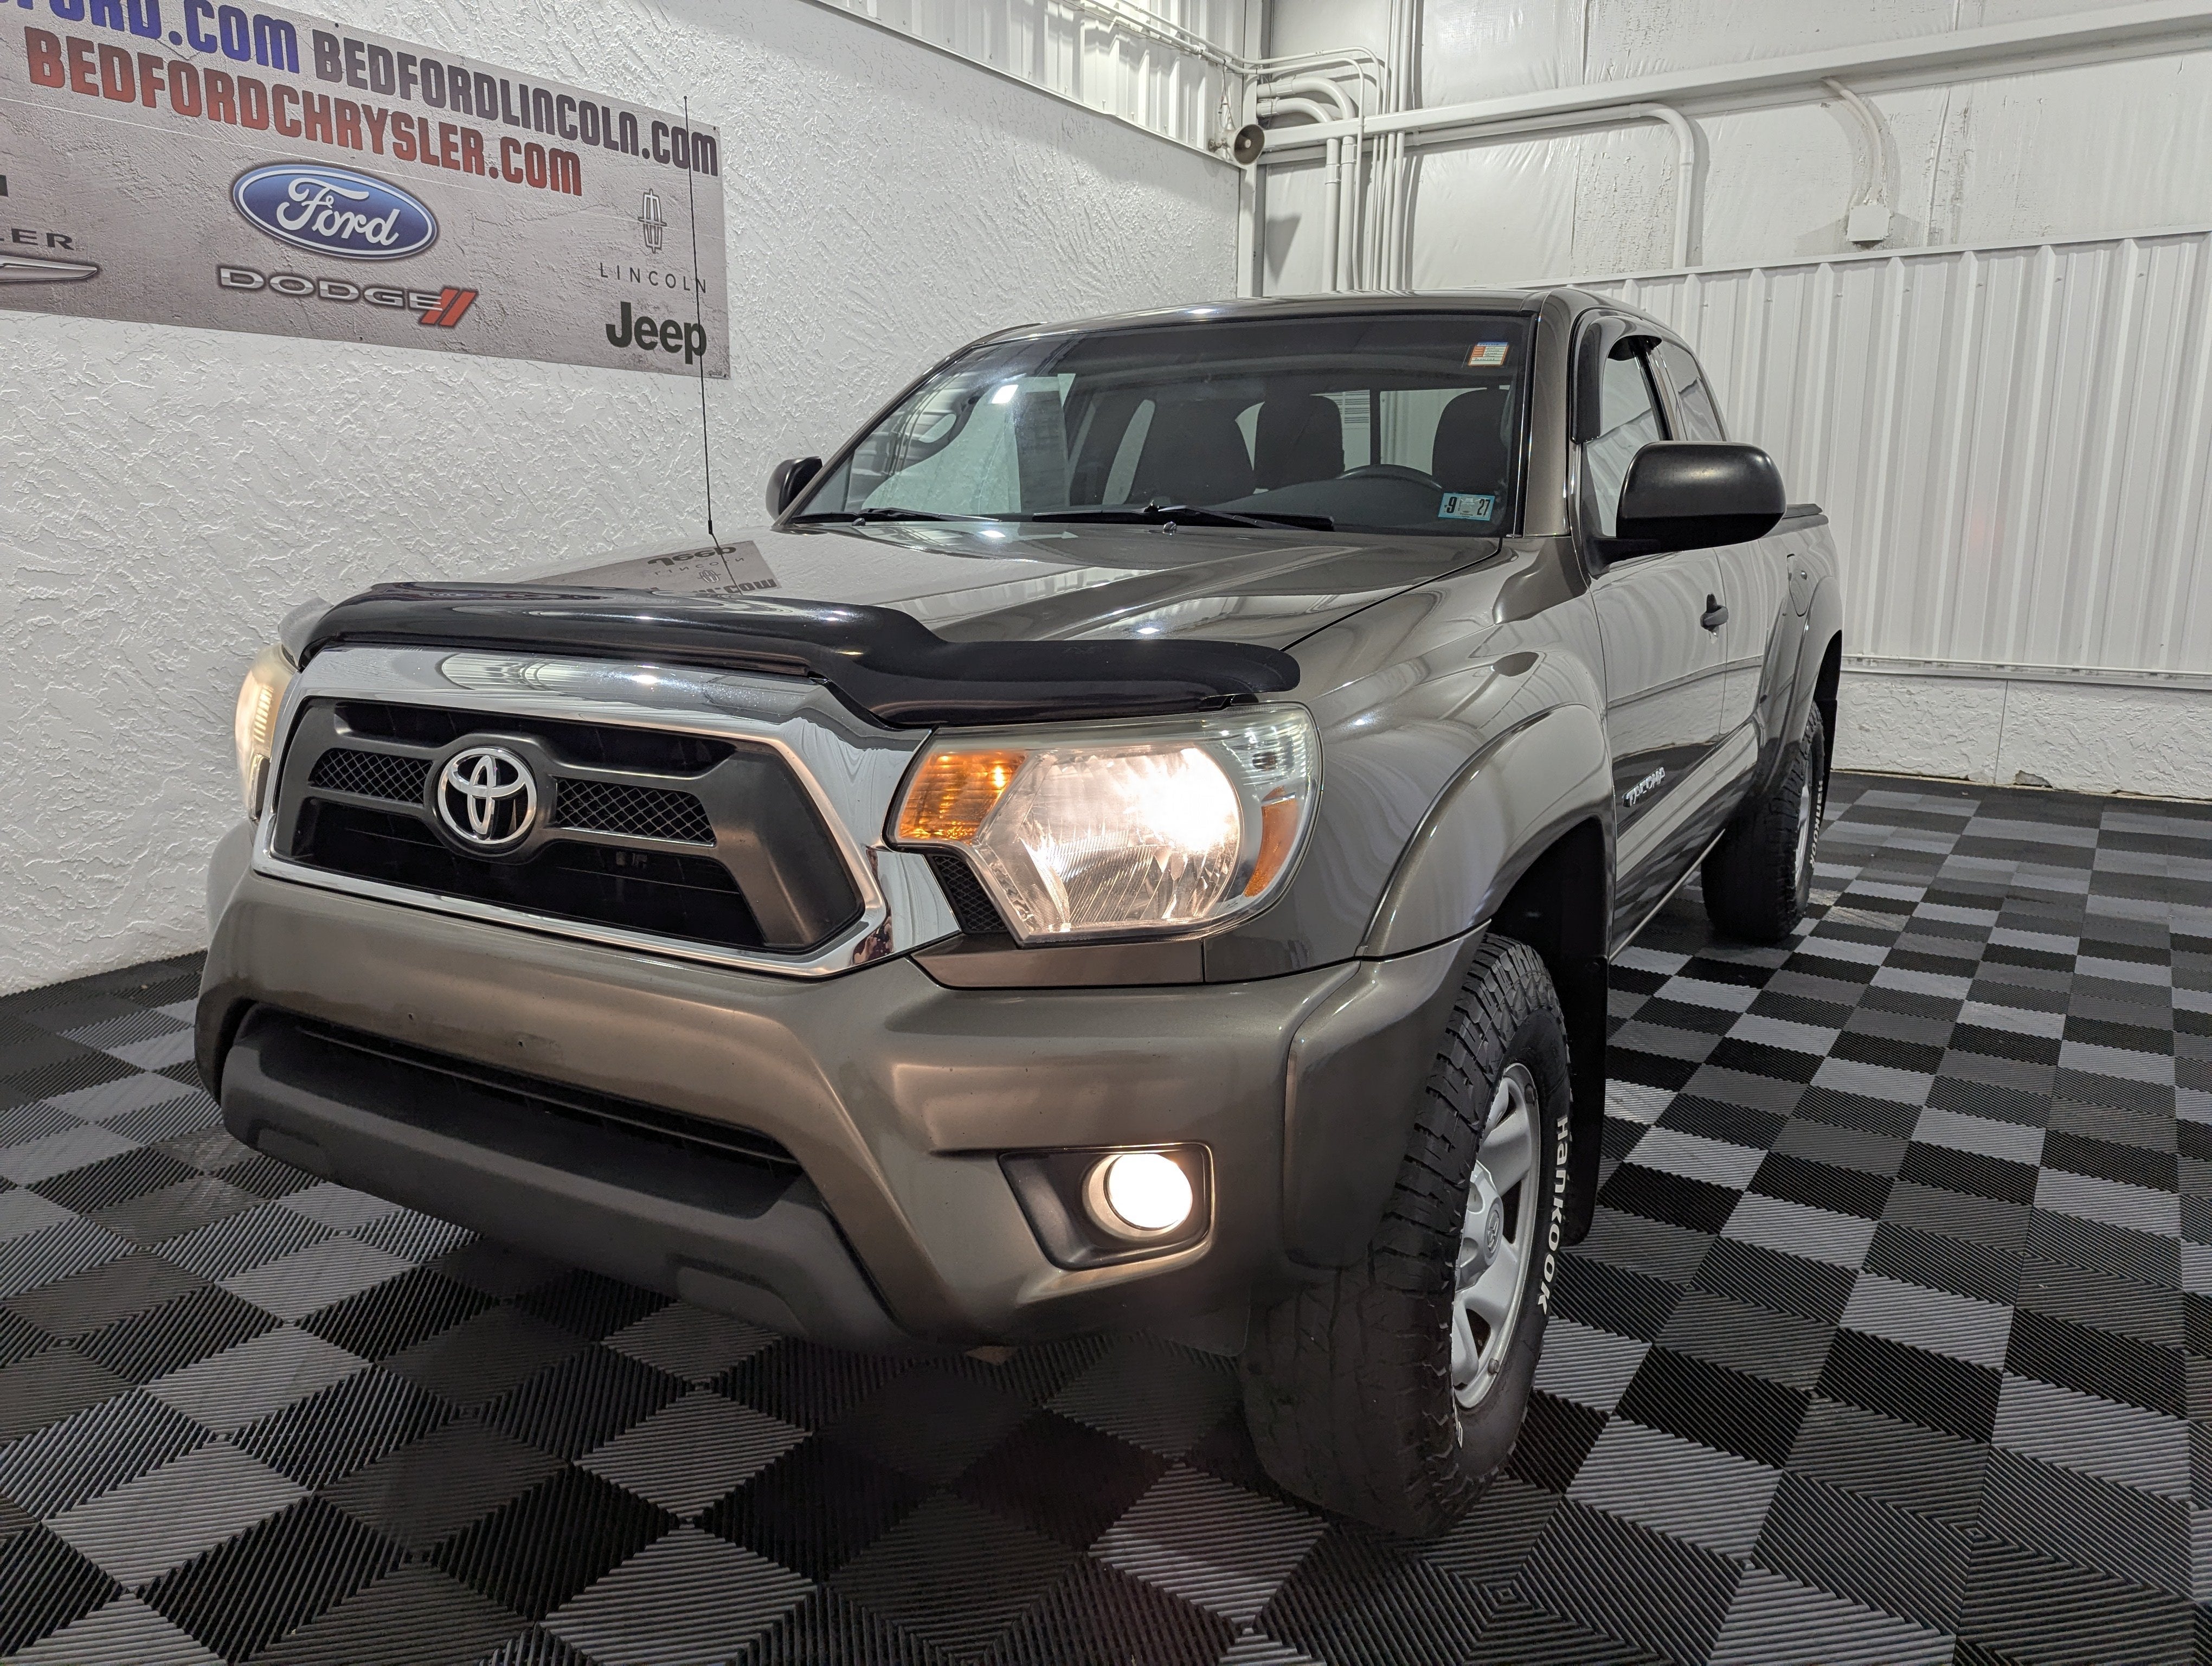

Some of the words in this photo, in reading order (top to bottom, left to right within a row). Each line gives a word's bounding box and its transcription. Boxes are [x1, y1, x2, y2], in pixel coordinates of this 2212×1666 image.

[0, 0, 300, 74] RD.COM
[312, 29, 718, 177] BEDFORDLINCOLN.COM
[24, 26, 582, 197] BEDFORDCHRYSLER.COM
[0, 228, 74, 251] ER
[276, 177, 401, 247] Ford
[220, 268, 444, 311] DODGE
[600, 262, 706, 293] LINCOLN
[606, 301, 707, 365] Jeep
[1446, 496, 1457, 514] 9
[1477, 498, 1491, 516] 27
[1538, 1116, 1571, 1315] Hankook
